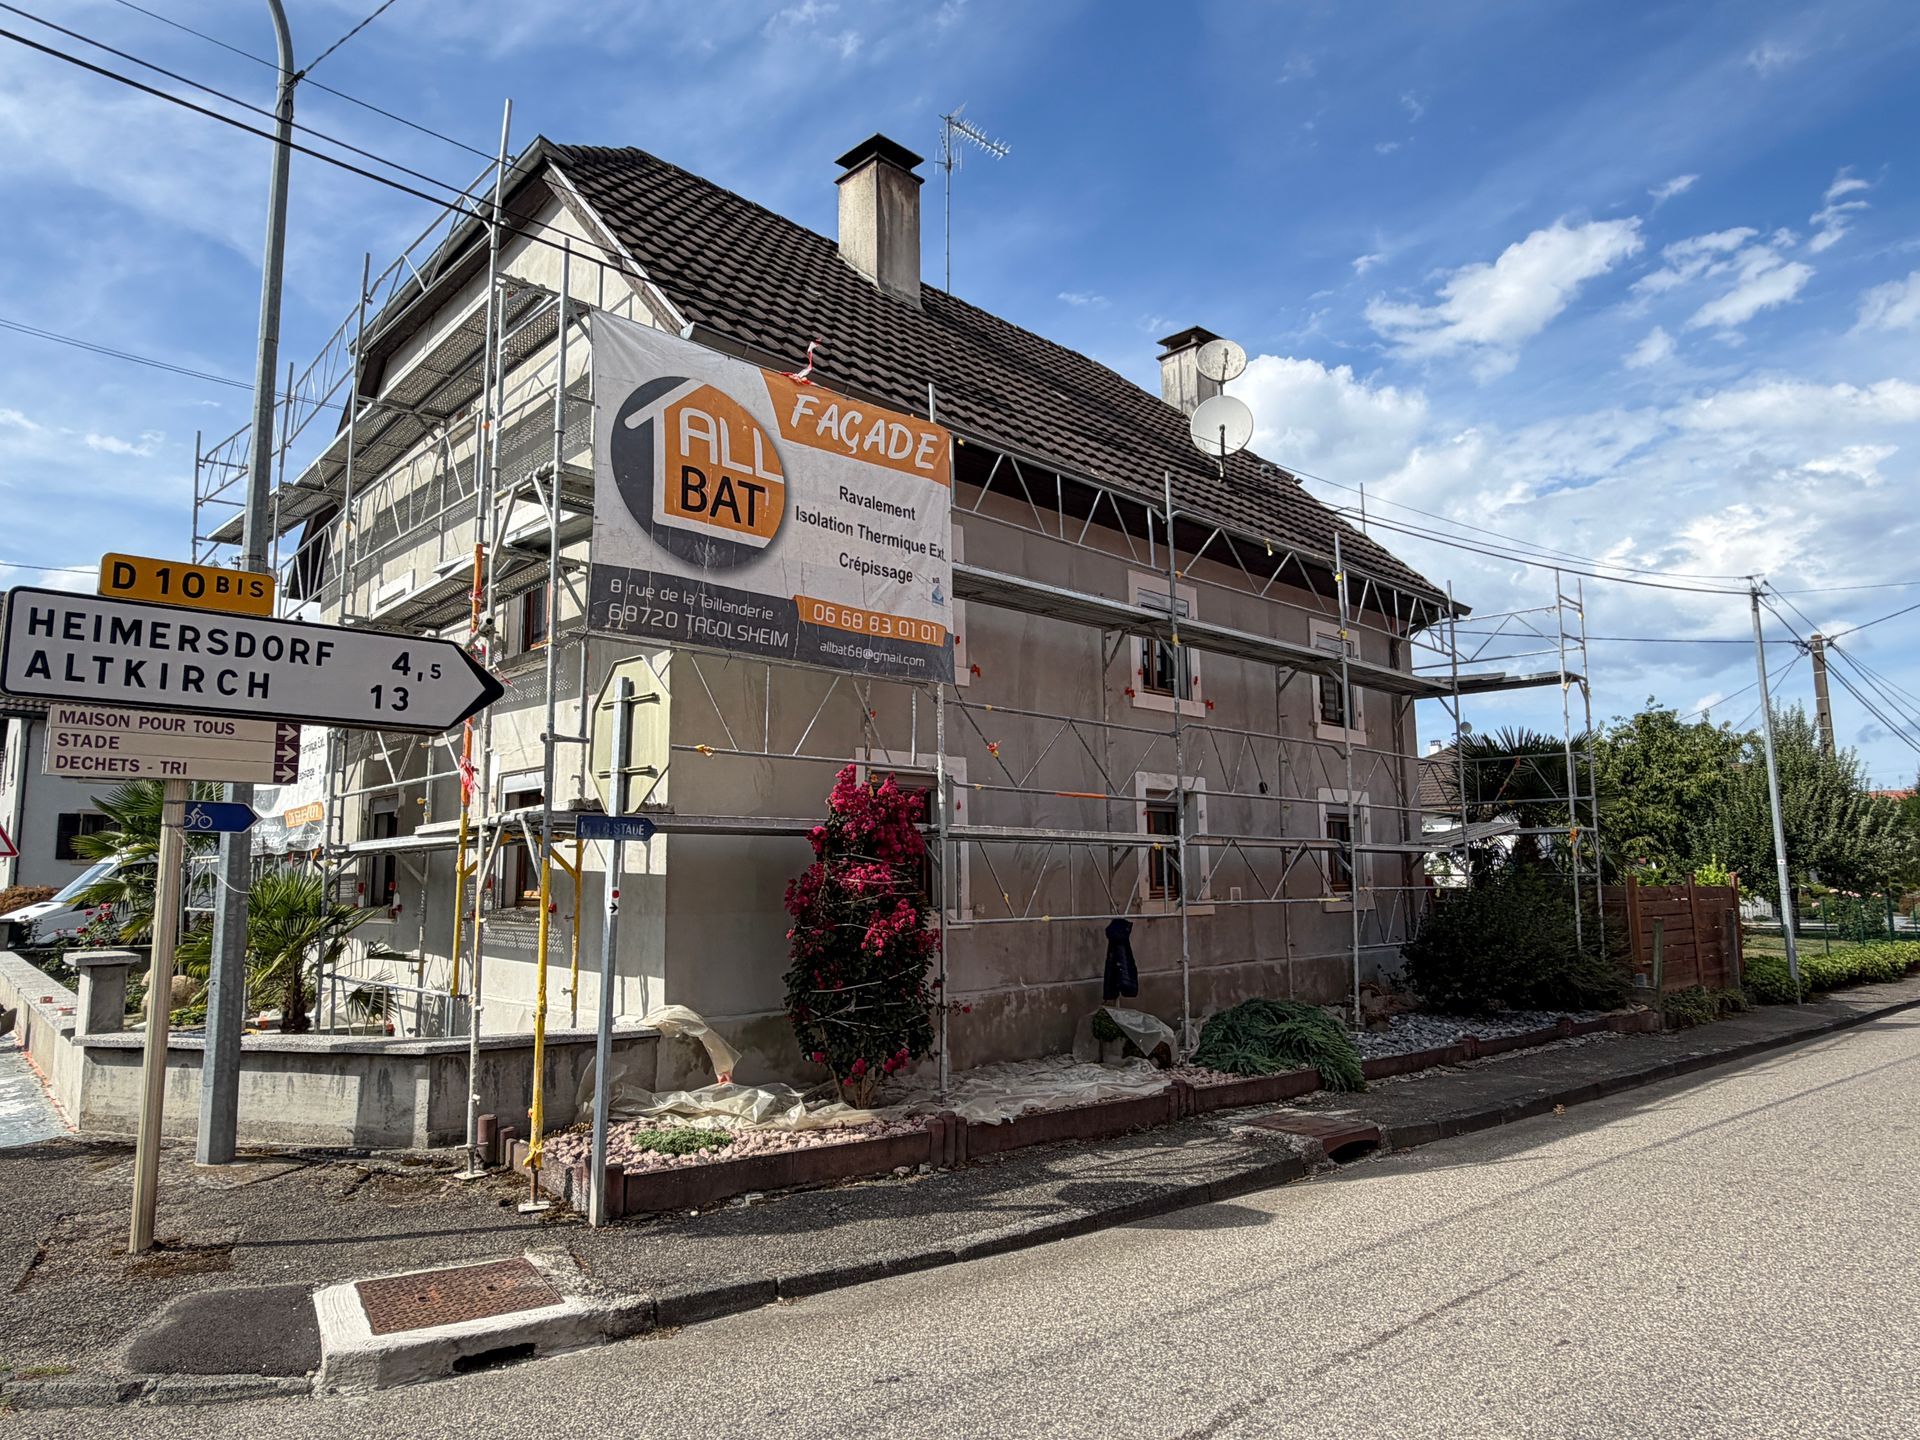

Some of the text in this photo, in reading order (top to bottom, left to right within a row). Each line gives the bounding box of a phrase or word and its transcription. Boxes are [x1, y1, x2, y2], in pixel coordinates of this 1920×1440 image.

[679, 406, 785, 485] ALL
[790, 393, 938, 470] FAÇADE
[681, 465, 766, 527] BAT
[838, 485, 916, 521] Ravalement
[795, 505, 947, 562] Isolation Thermique Ext.
[112, 561, 137, 590] D
[838, 552, 913, 584] Crépissage
[610, 578, 774, 621] 8 rue de la Taillanderie
[608, 603, 789, 648] 68720 TAGOLSHEIM
[813, 603, 937, 642] 06 68 83 01 01
[28, 606, 442, 682] HEIMERSDORF 4,5
[819, 641, 925, 668] allbat68@gmail.com
[24, 649, 409, 711] ALTKIRCH 13
[57, 732, 120, 750] STADE
[59, 709, 236, 736] MAISON POUR TOUS
[55, 755, 140, 773] DECHETS
[160, 760, 188, 775] TRI
